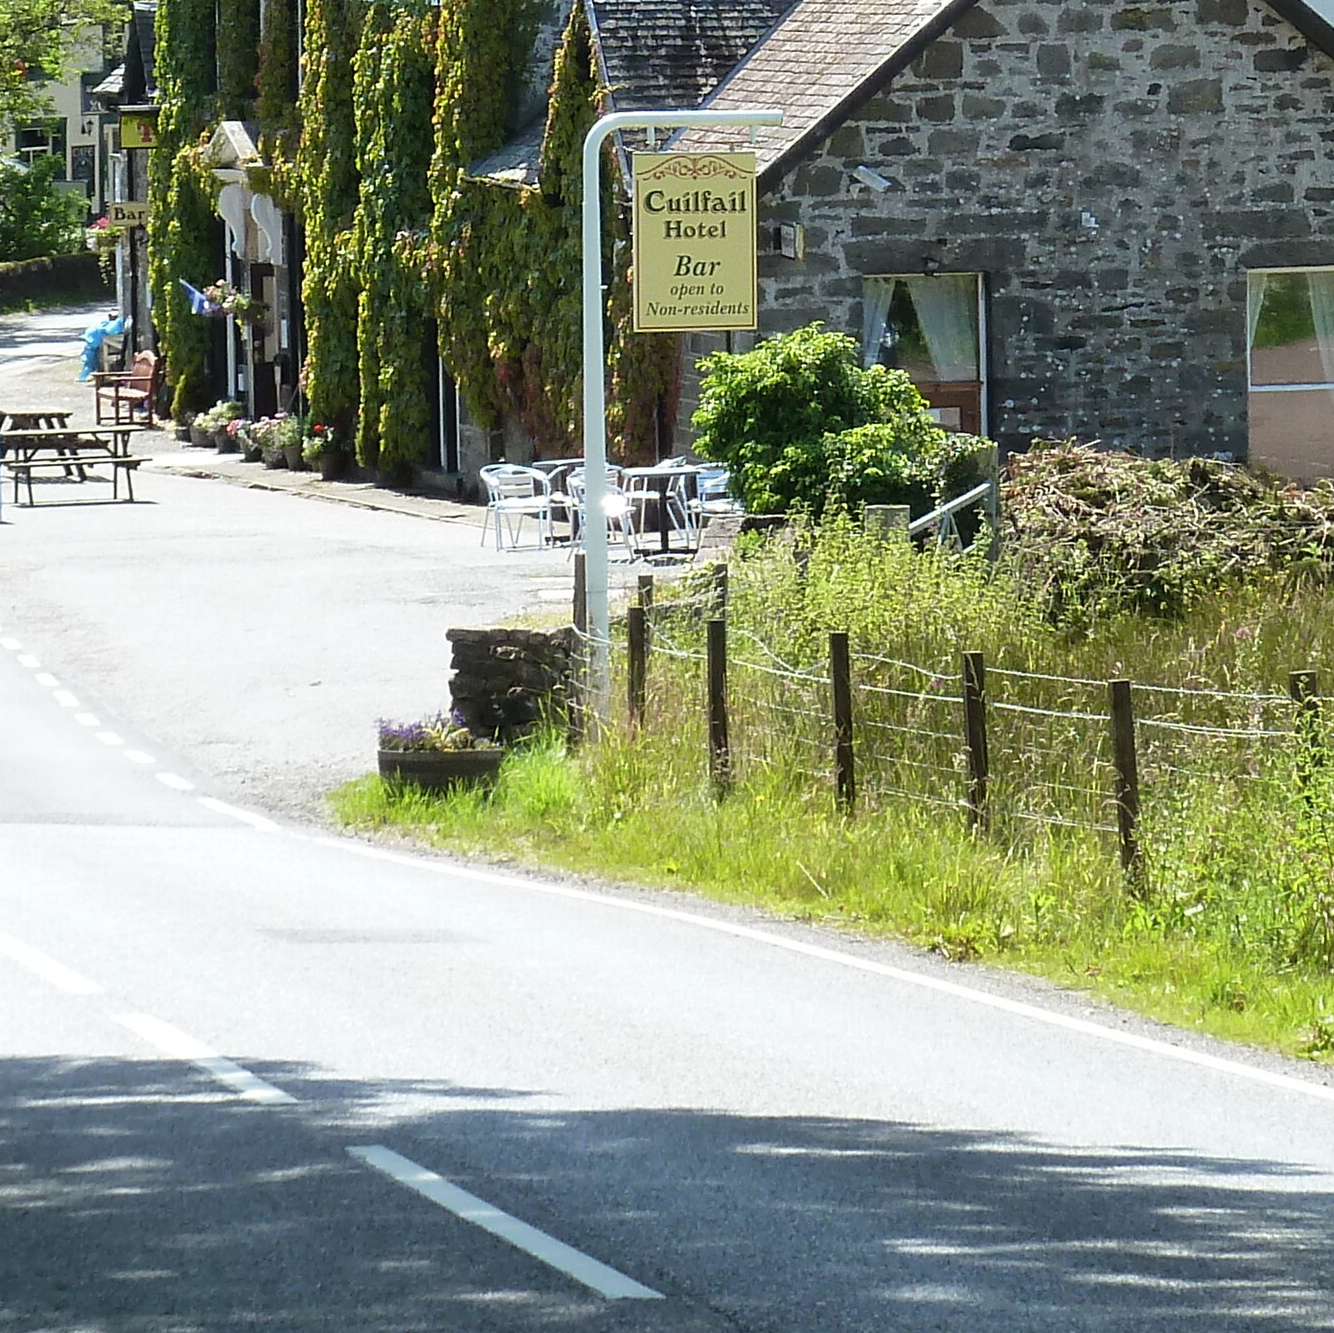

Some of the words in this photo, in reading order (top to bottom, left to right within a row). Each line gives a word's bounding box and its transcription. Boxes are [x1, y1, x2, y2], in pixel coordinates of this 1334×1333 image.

[643, 190, 747, 215] Cuilfail
[114, 207, 146, 221] Bar
[663, 220, 727, 239] Hotel
[674, 255, 721, 277] Bar
[670, 283, 705, 300] open
[710, 283, 724, 295] to
[646, 300, 750, 316] Non-residents
